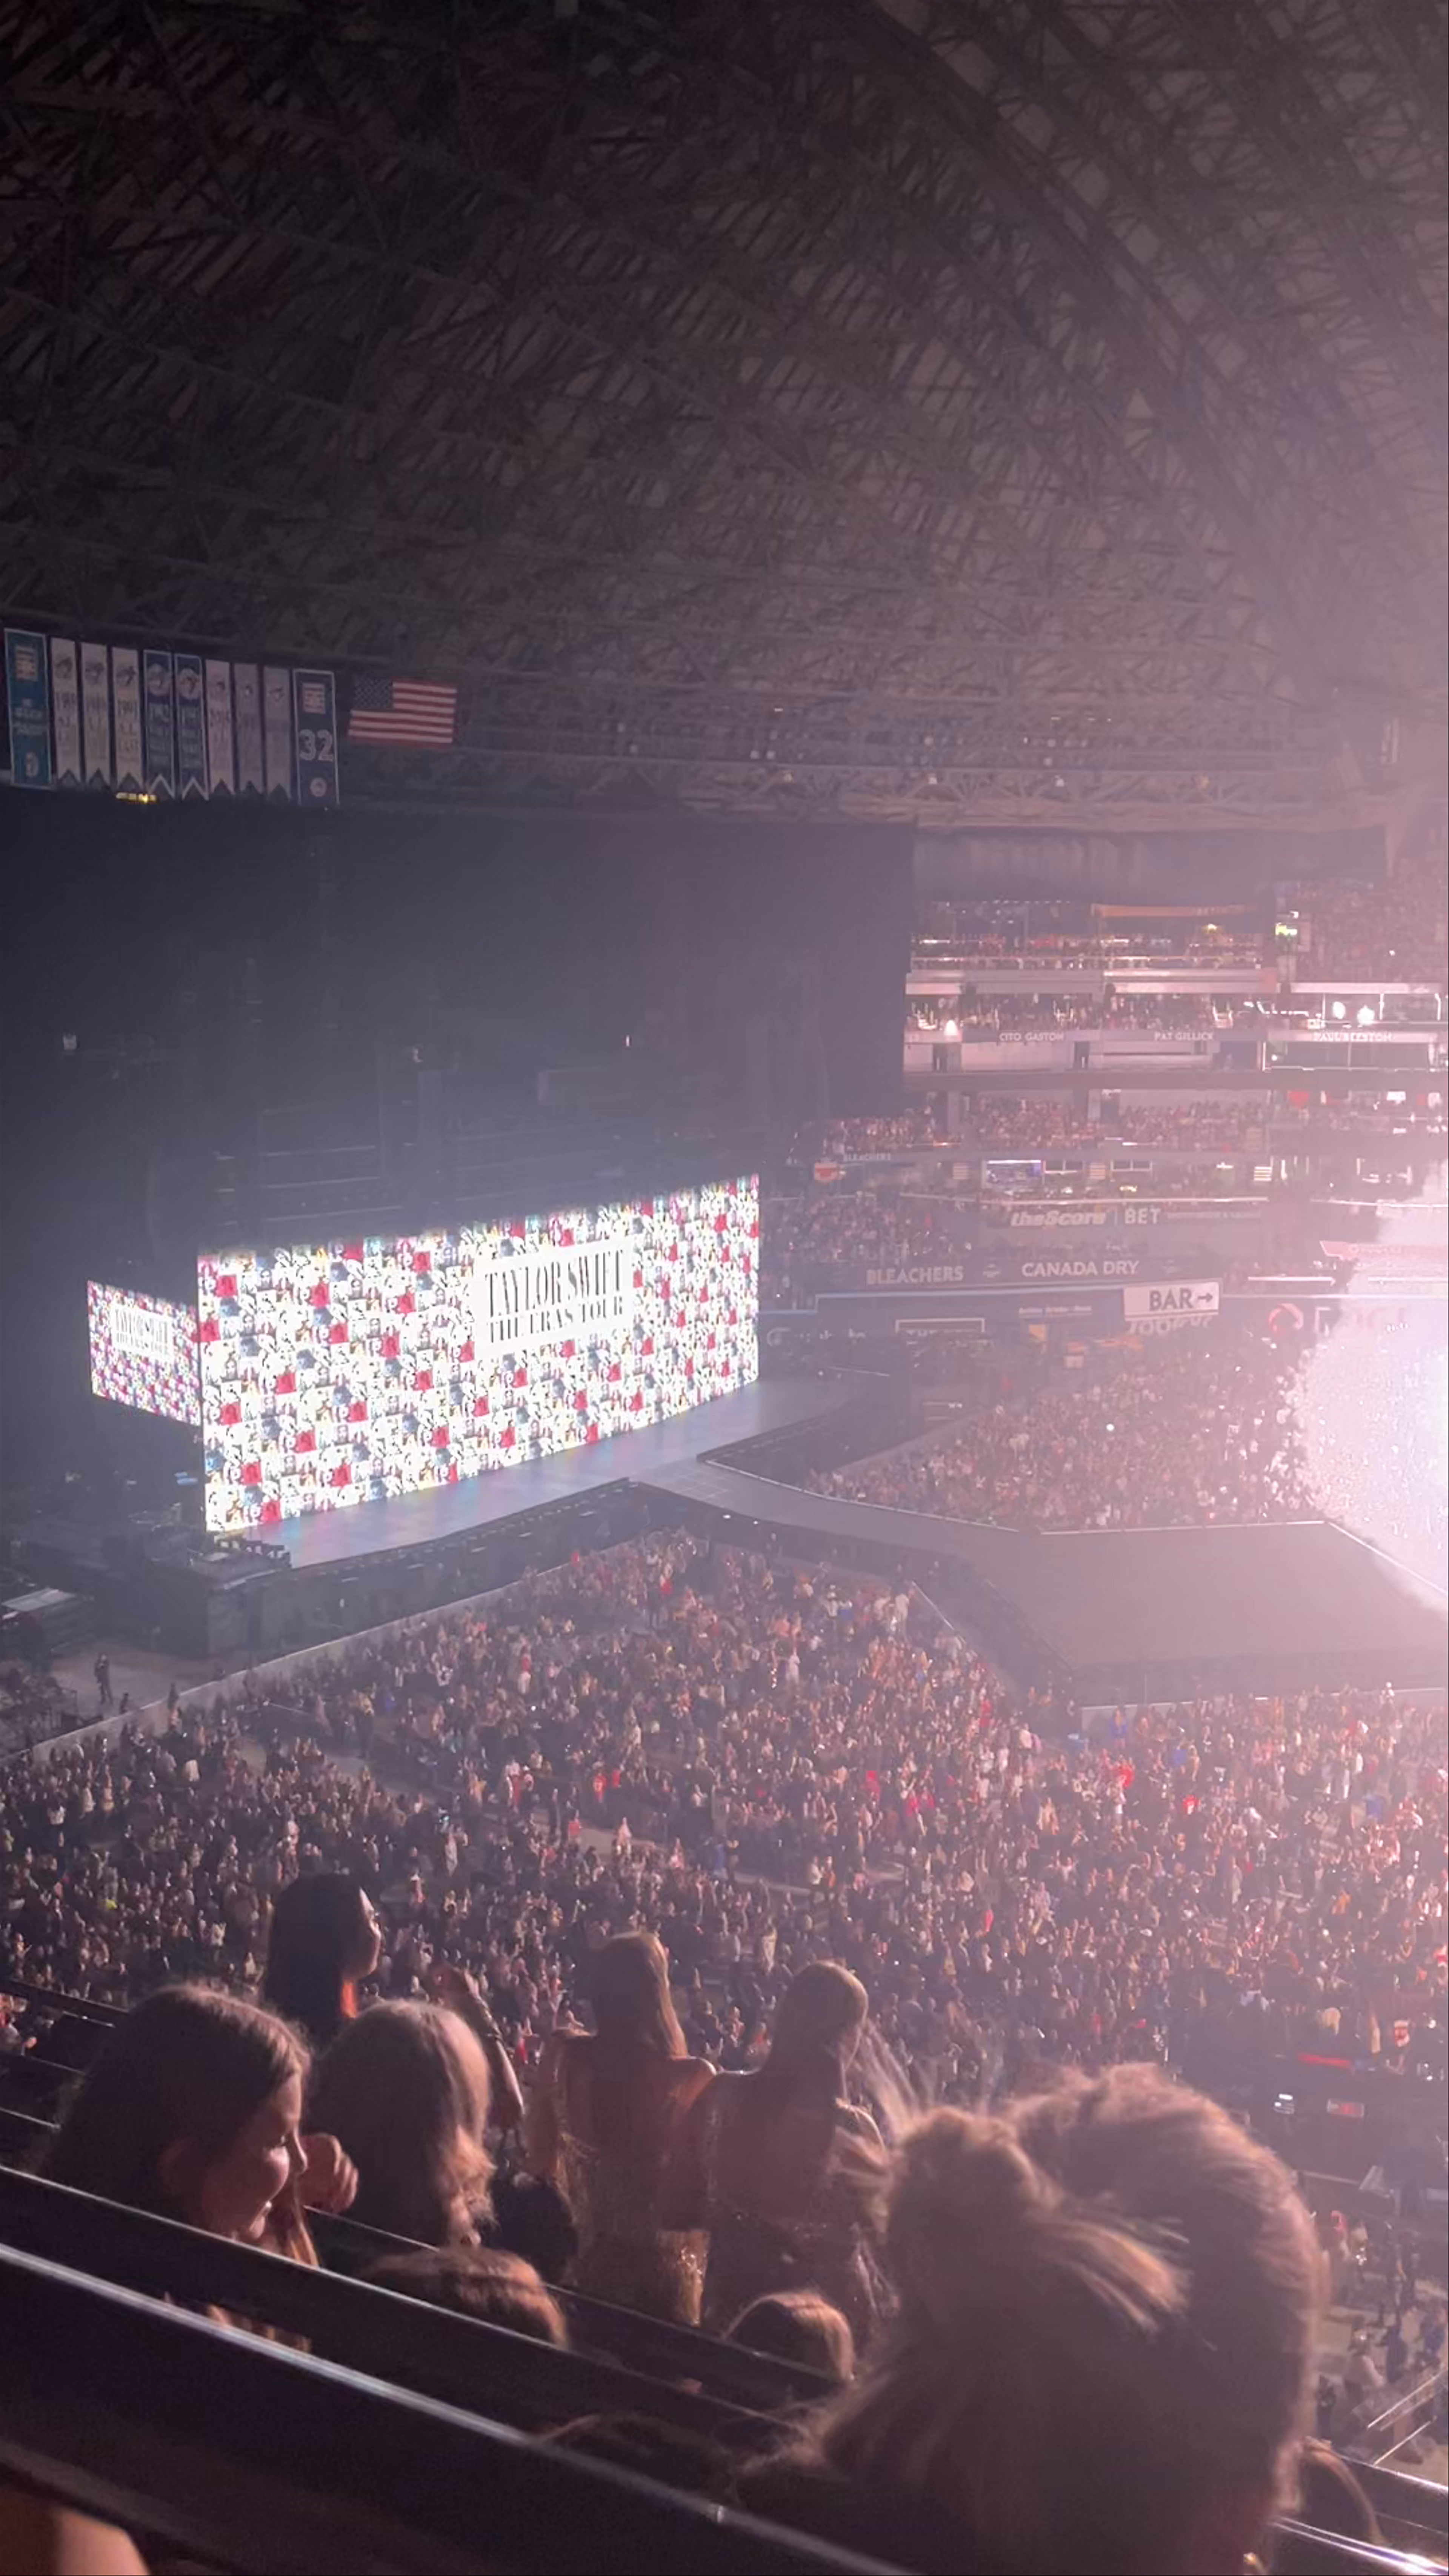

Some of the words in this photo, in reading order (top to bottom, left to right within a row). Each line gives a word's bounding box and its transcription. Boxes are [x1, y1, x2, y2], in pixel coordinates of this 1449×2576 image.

[299, 729, 334, 761] 32
[999, 1032, 1021, 1041] CITO
[1025, 1032, 1064, 1041] GASTON
[1154, 1032, 1172, 1041] PAT
[1175, 1032, 1214, 1041] GILLICK
[1124, 1208, 1161, 1224] BET
[868, 1266, 964, 1284] BLEACHERS
[1021, 1261, 1098, 1277] CANADA
[1103, 1260, 1140, 1275] DRY
[485, 1261, 561, 1318] TAYLOR
[568, 1249, 623, 1300] SWIFT
[1149, 1287, 1193, 1311] BAR
[486, 1316, 525, 1343] THE
[529, 1308, 574, 1333] ERAS
[579, 1296, 622, 1323] TOUR
